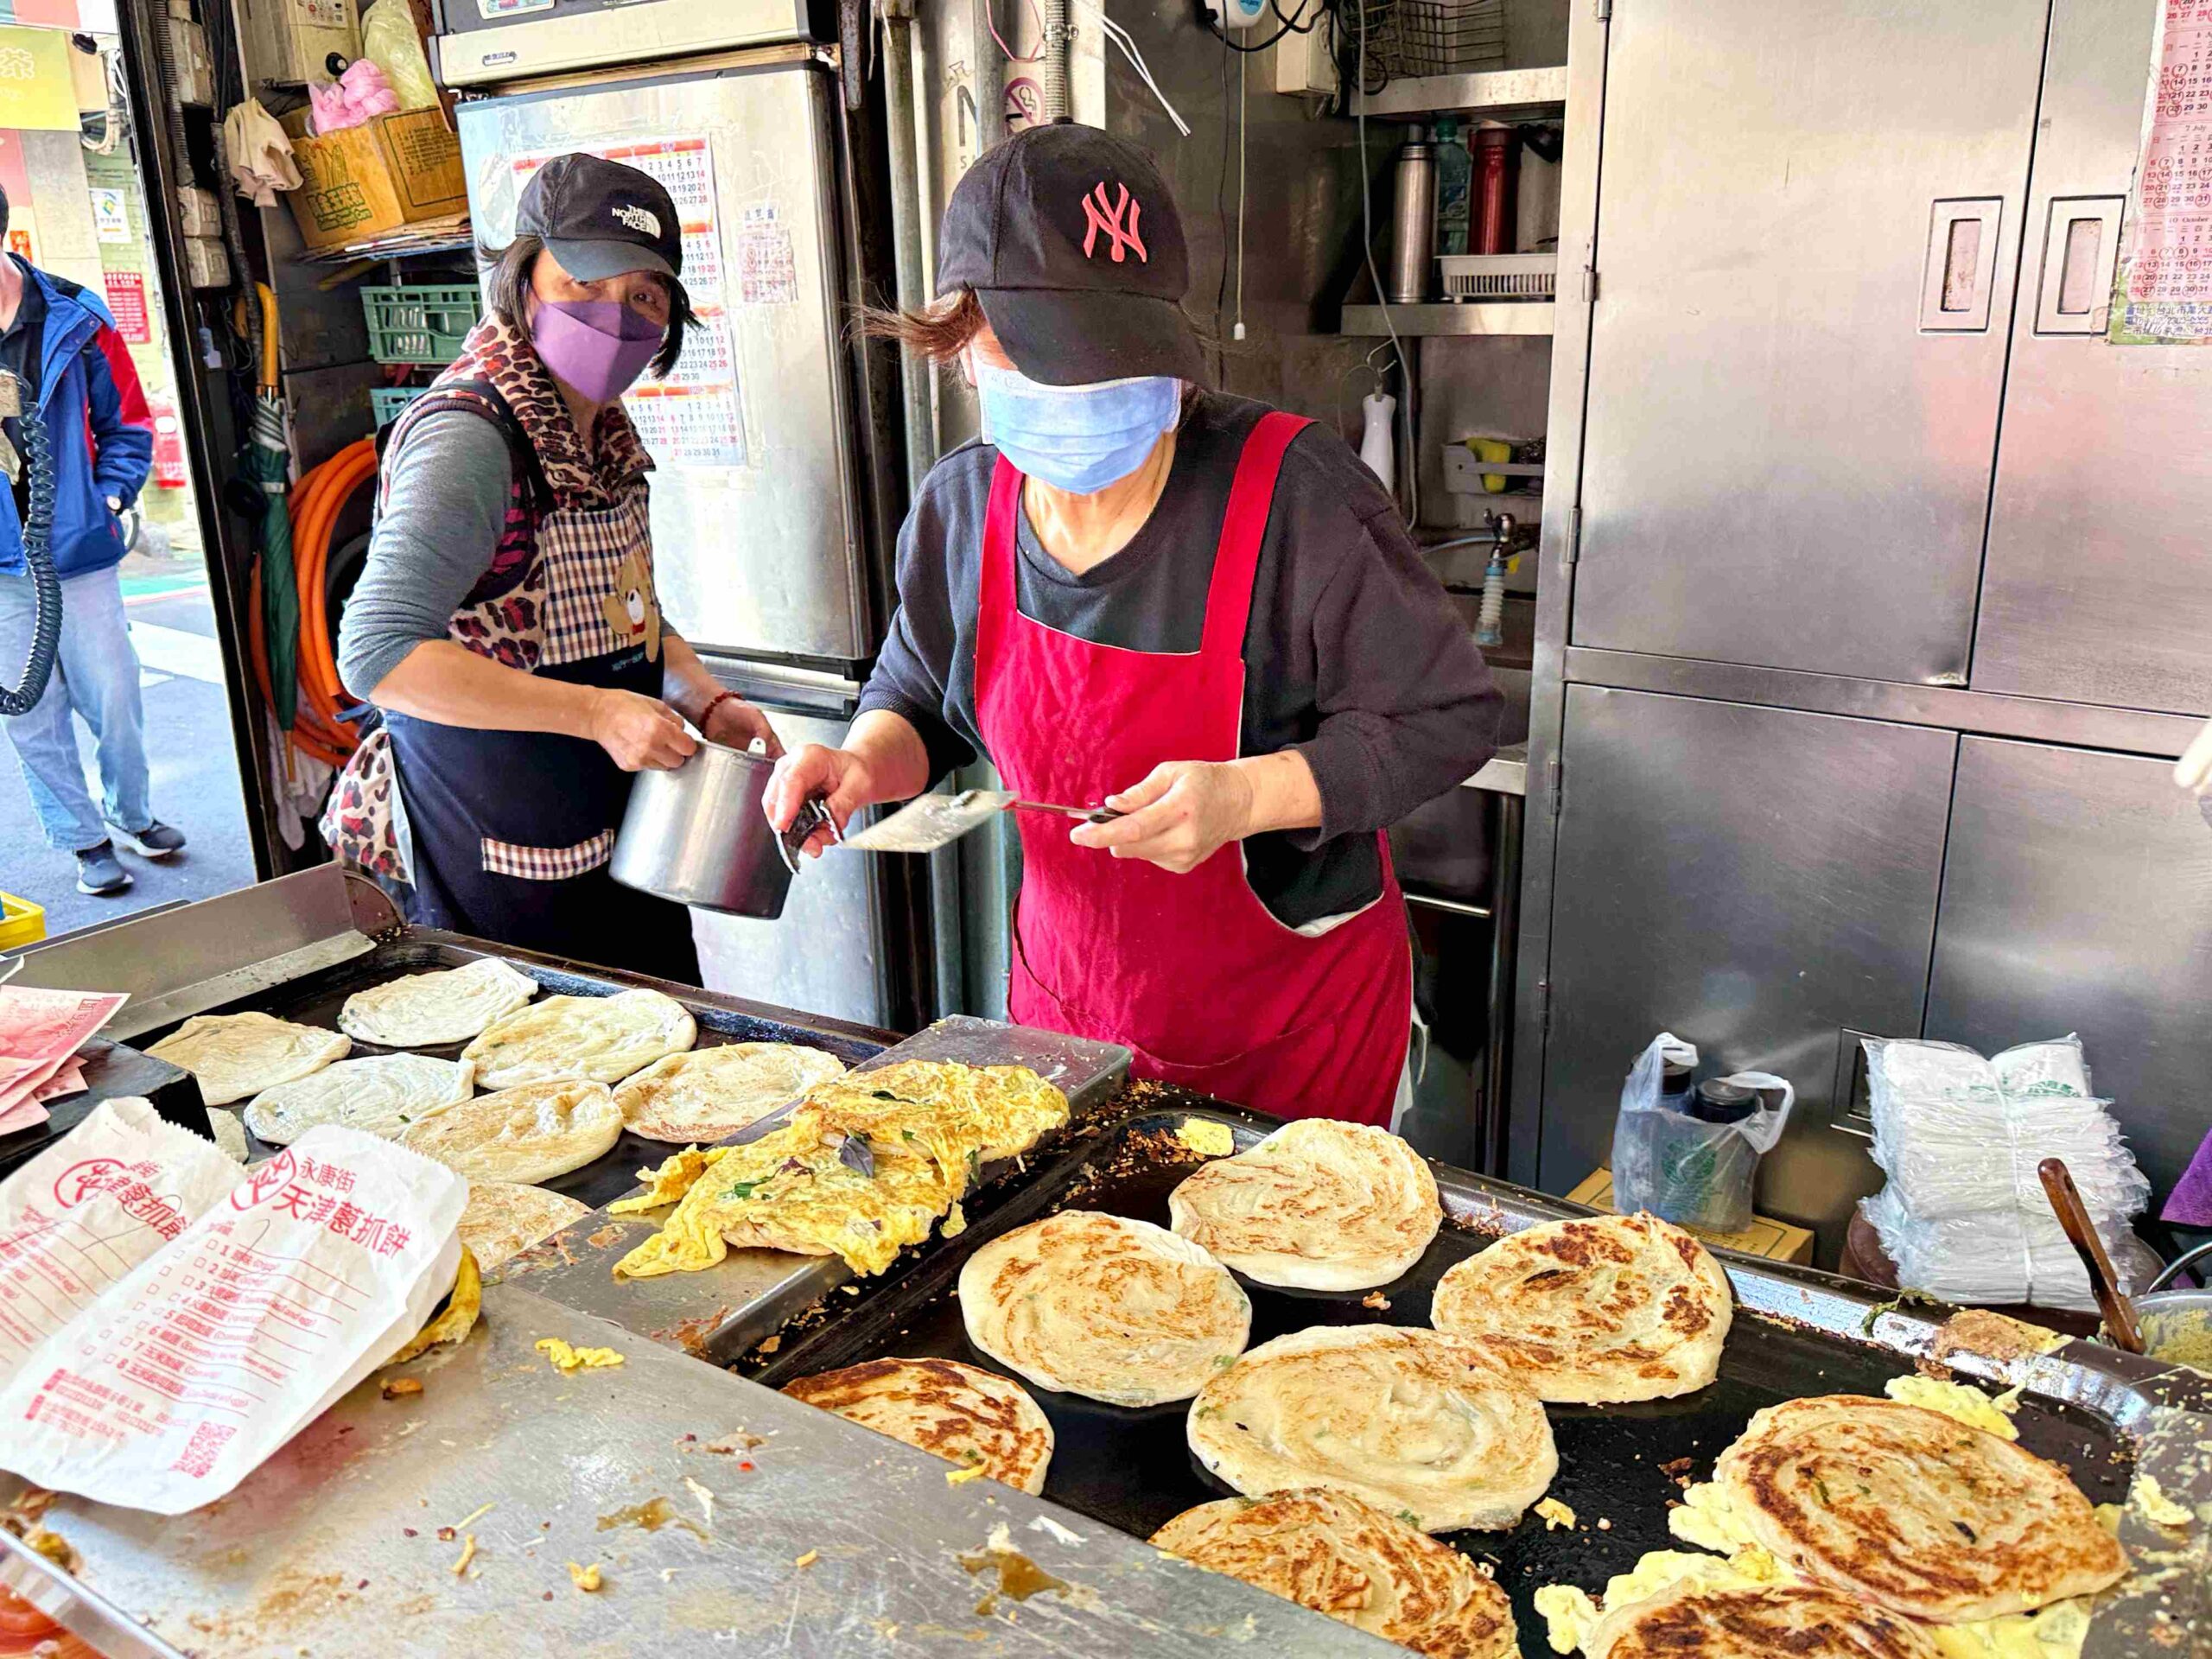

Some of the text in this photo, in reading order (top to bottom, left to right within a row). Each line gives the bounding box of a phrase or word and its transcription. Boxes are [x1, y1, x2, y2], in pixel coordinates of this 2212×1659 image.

[612, 207, 648, 225] NORTH
[623, 216, 648, 232] FACE
[1082, 181, 1147, 263] NY
[300, 1156, 357, 1193] 永康街
[207, 1263, 219, 1274] 2
[195, 1281, 206, 1291] 3
[164, 1310, 176, 1319] 5
[149, 1325, 161, 1336] 6
[134, 1341, 145, 1351] 7
[117, 1358, 129, 1369] 8
